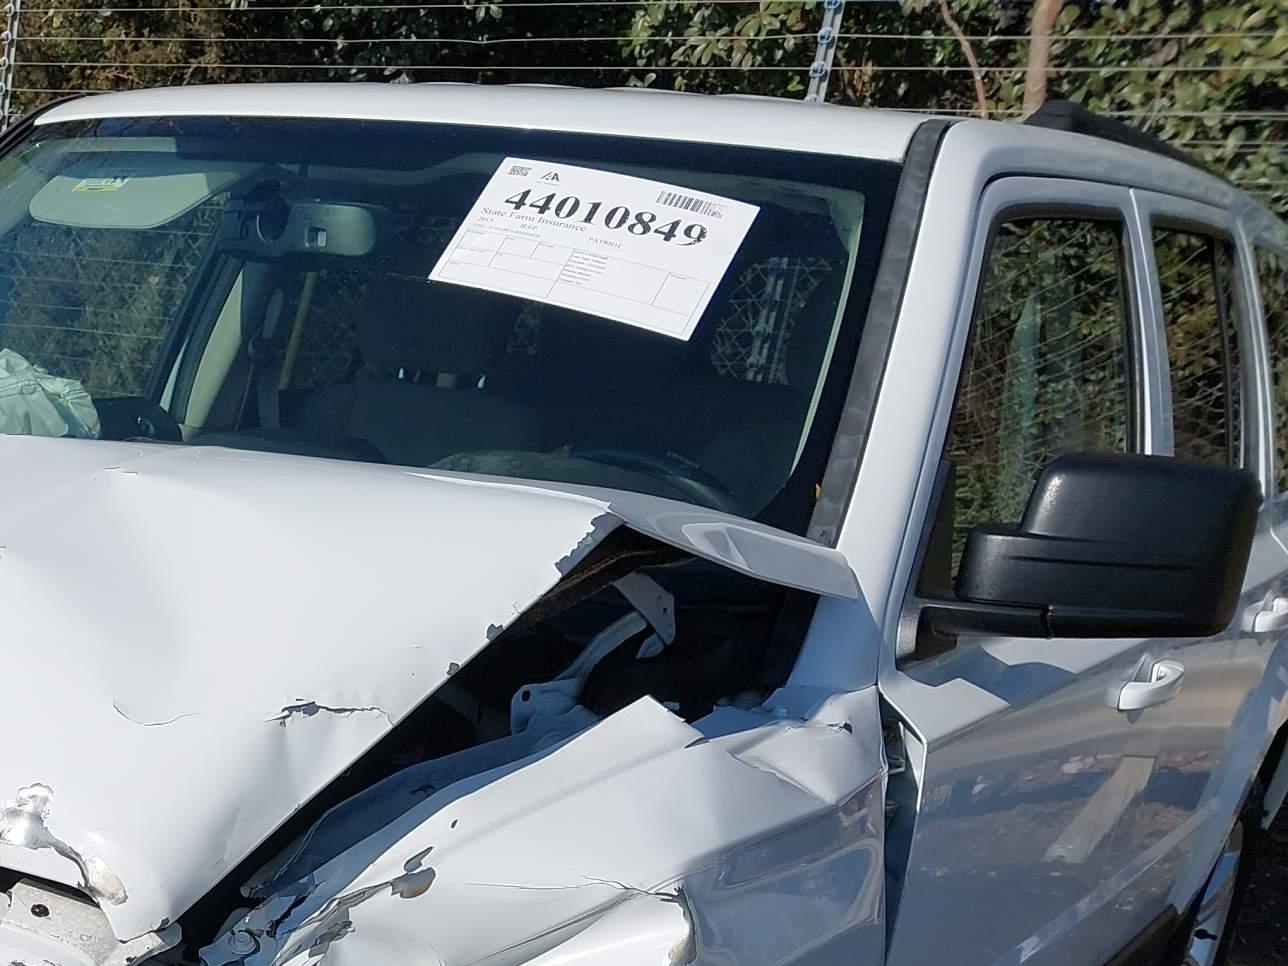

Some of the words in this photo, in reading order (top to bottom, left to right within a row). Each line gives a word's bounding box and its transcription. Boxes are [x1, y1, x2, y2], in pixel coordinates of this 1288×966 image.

[481, 207, 507, 217] State
[508, 211, 535, 222] Farm
[537, 215, 587, 232] Insurance
[503, 188, 708, 246] 44010849
[587, 236, 624, 249] PATRIOT
